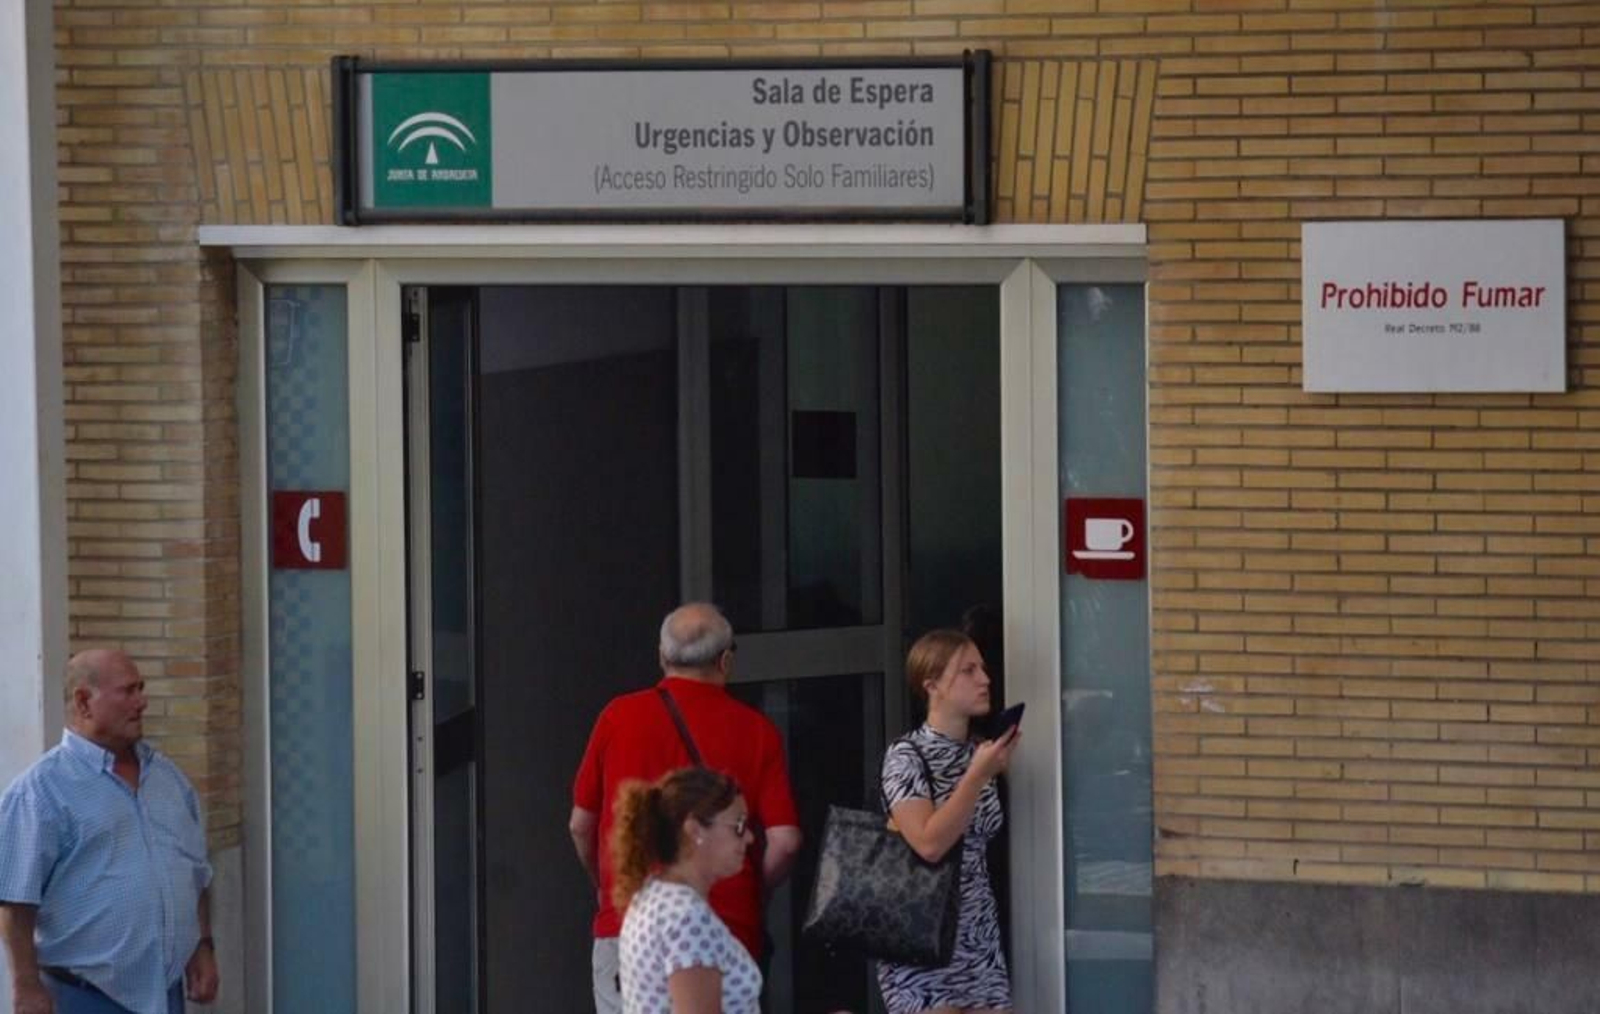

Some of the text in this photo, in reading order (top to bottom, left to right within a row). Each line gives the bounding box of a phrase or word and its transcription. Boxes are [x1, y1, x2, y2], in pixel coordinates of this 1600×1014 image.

[753, 76, 933, 110] Sala de Espera
[635, 119, 934, 155] Urgencias y Observación
[594, 163, 934, 194] (Acceso Restringido Solo Familiares)
[1321, 281, 1546, 309] Prohibido Fumar
[1384, 323, 1405, 333] Real
[1408, 323, 1446, 334] Decreto
